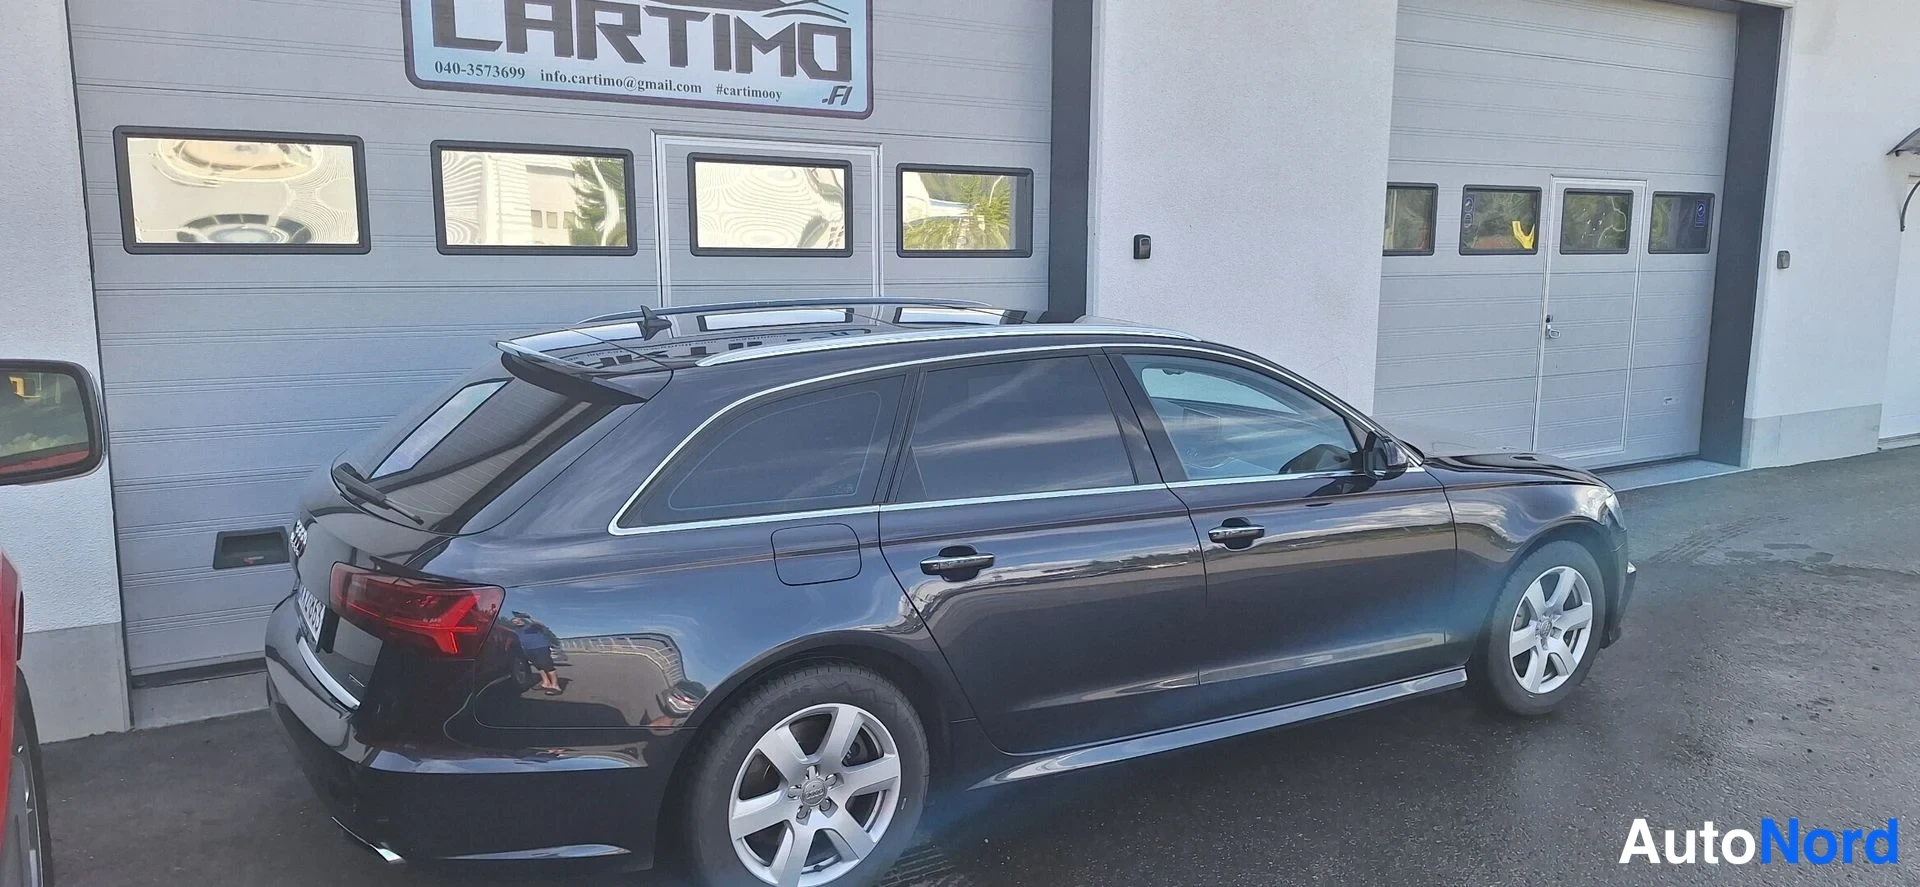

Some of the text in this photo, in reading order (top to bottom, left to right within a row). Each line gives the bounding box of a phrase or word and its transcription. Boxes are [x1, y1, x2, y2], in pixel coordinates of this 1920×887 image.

[434, 60, 783, 102] 040-3573699 info.cartimo@gmail.com #cartimooy
[822, 85, 853, 106] .FI
